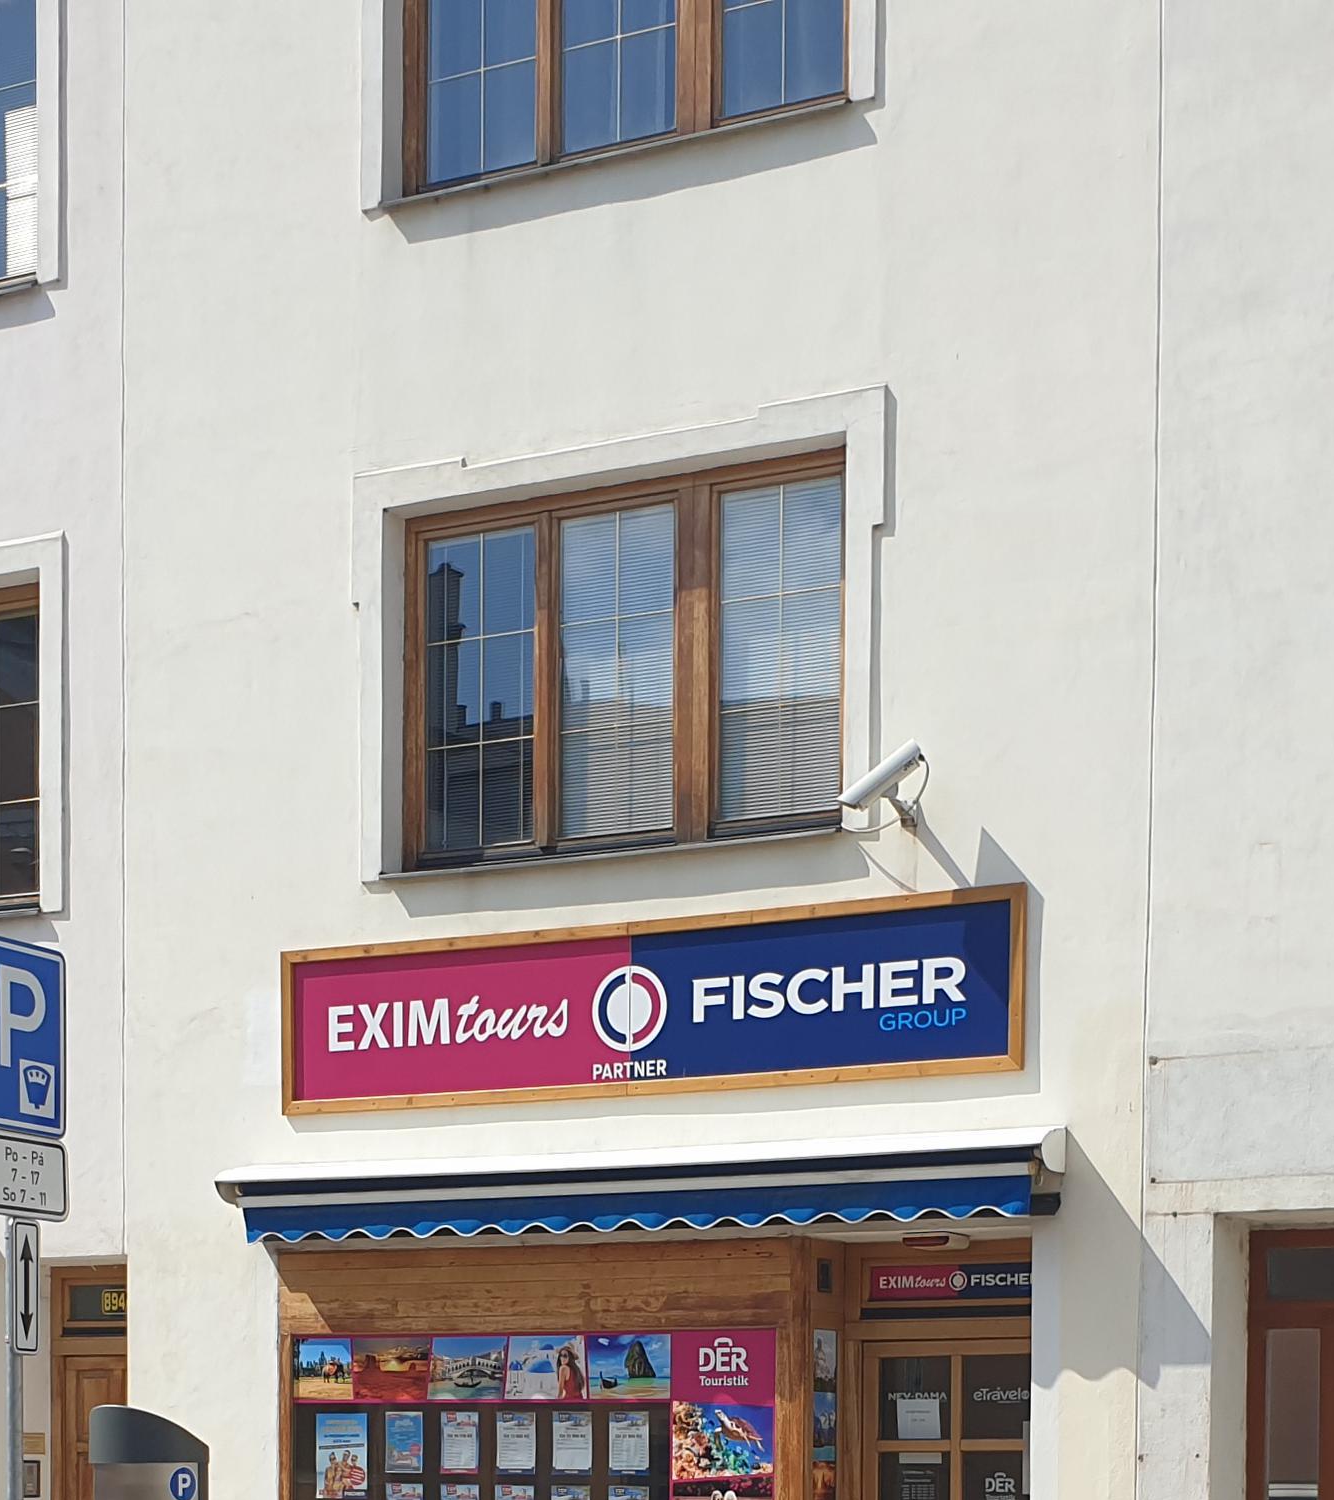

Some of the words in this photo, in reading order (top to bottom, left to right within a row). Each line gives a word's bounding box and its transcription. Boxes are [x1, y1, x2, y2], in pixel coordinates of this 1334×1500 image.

[693, 957, 967, 1023] FISCHER
[0, 964, 46, 1068] P
[327, 994, 568, 1052] EXIMtours
[879, 1008, 967, 1032] GROUP
[592, 1059, 667, 1080] PARTNER
[5, 1147, 18, 1162] Po
[31, 1151, 44, 1166] Pá
[11, 1168, 17, 1182] 7
[31, 1170, 40, 1185] 17
[2, 1187, 16, 1202] So
[20, 1189, 26, 1203] 7
[40, 1192, 47, 1206] 11
[879, 1276, 946, 1289] EXIMtours
[970, 1273, 1033, 1287] FISCHE
[699, 1347, 749, 1372] DER
[699, 1375, 749, 1386] Touristik
[178, 1474, 191, 1497] P
[985, 1478, 1016, 1493] DER
